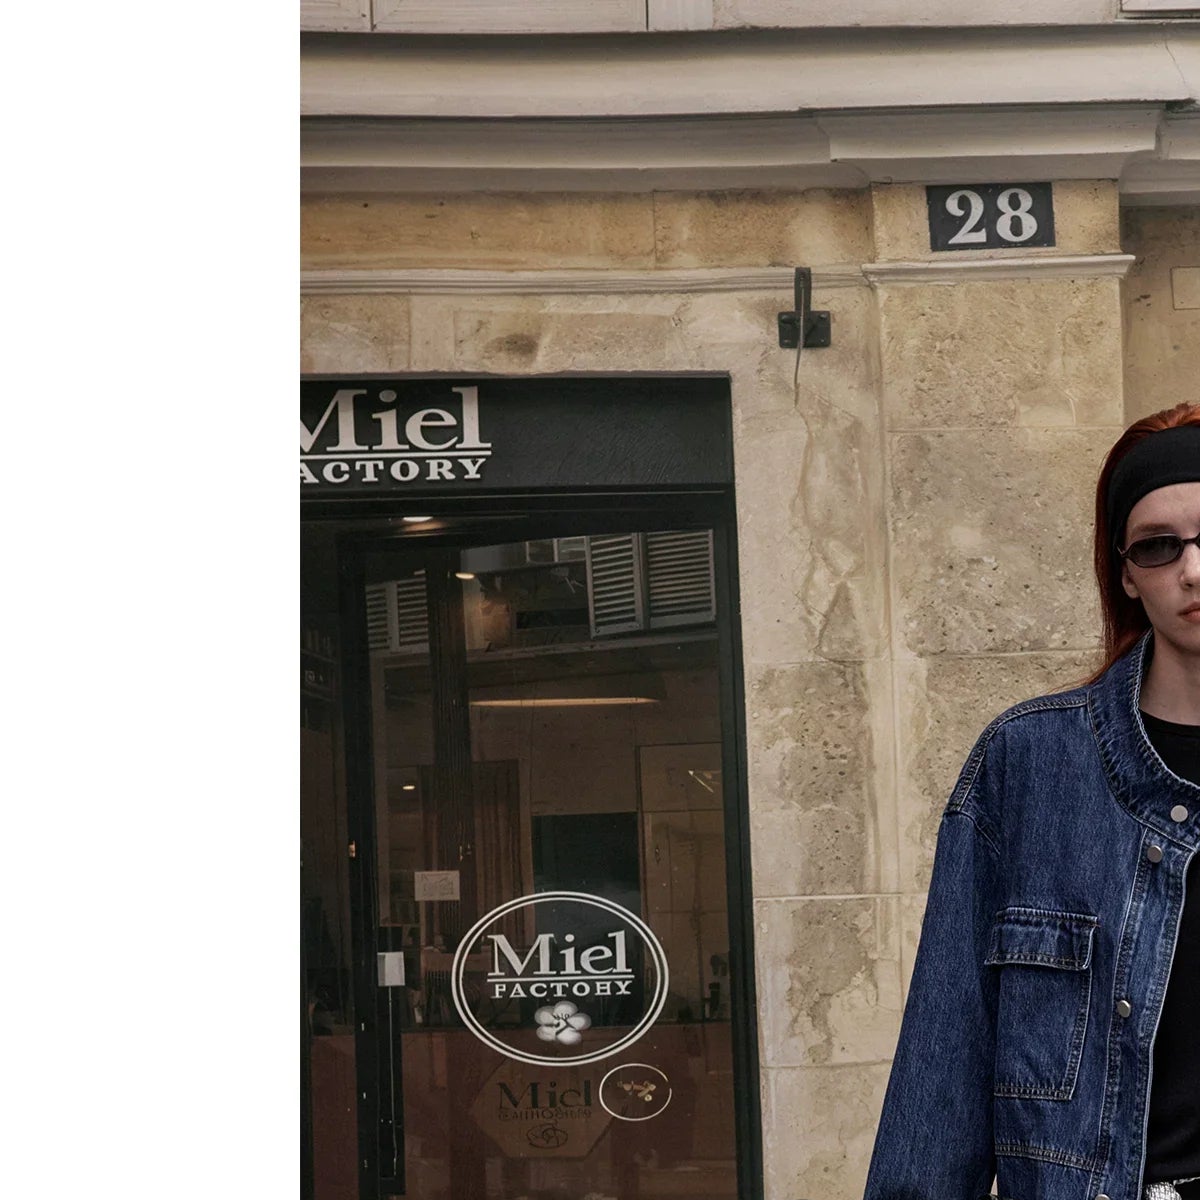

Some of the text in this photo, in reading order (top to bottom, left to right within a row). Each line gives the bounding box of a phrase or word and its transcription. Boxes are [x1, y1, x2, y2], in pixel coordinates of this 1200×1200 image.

[945, 188, 1038, 244] 28
[300, 385, 492, 453] Miel
[487, 930, 632, 976] Miel
